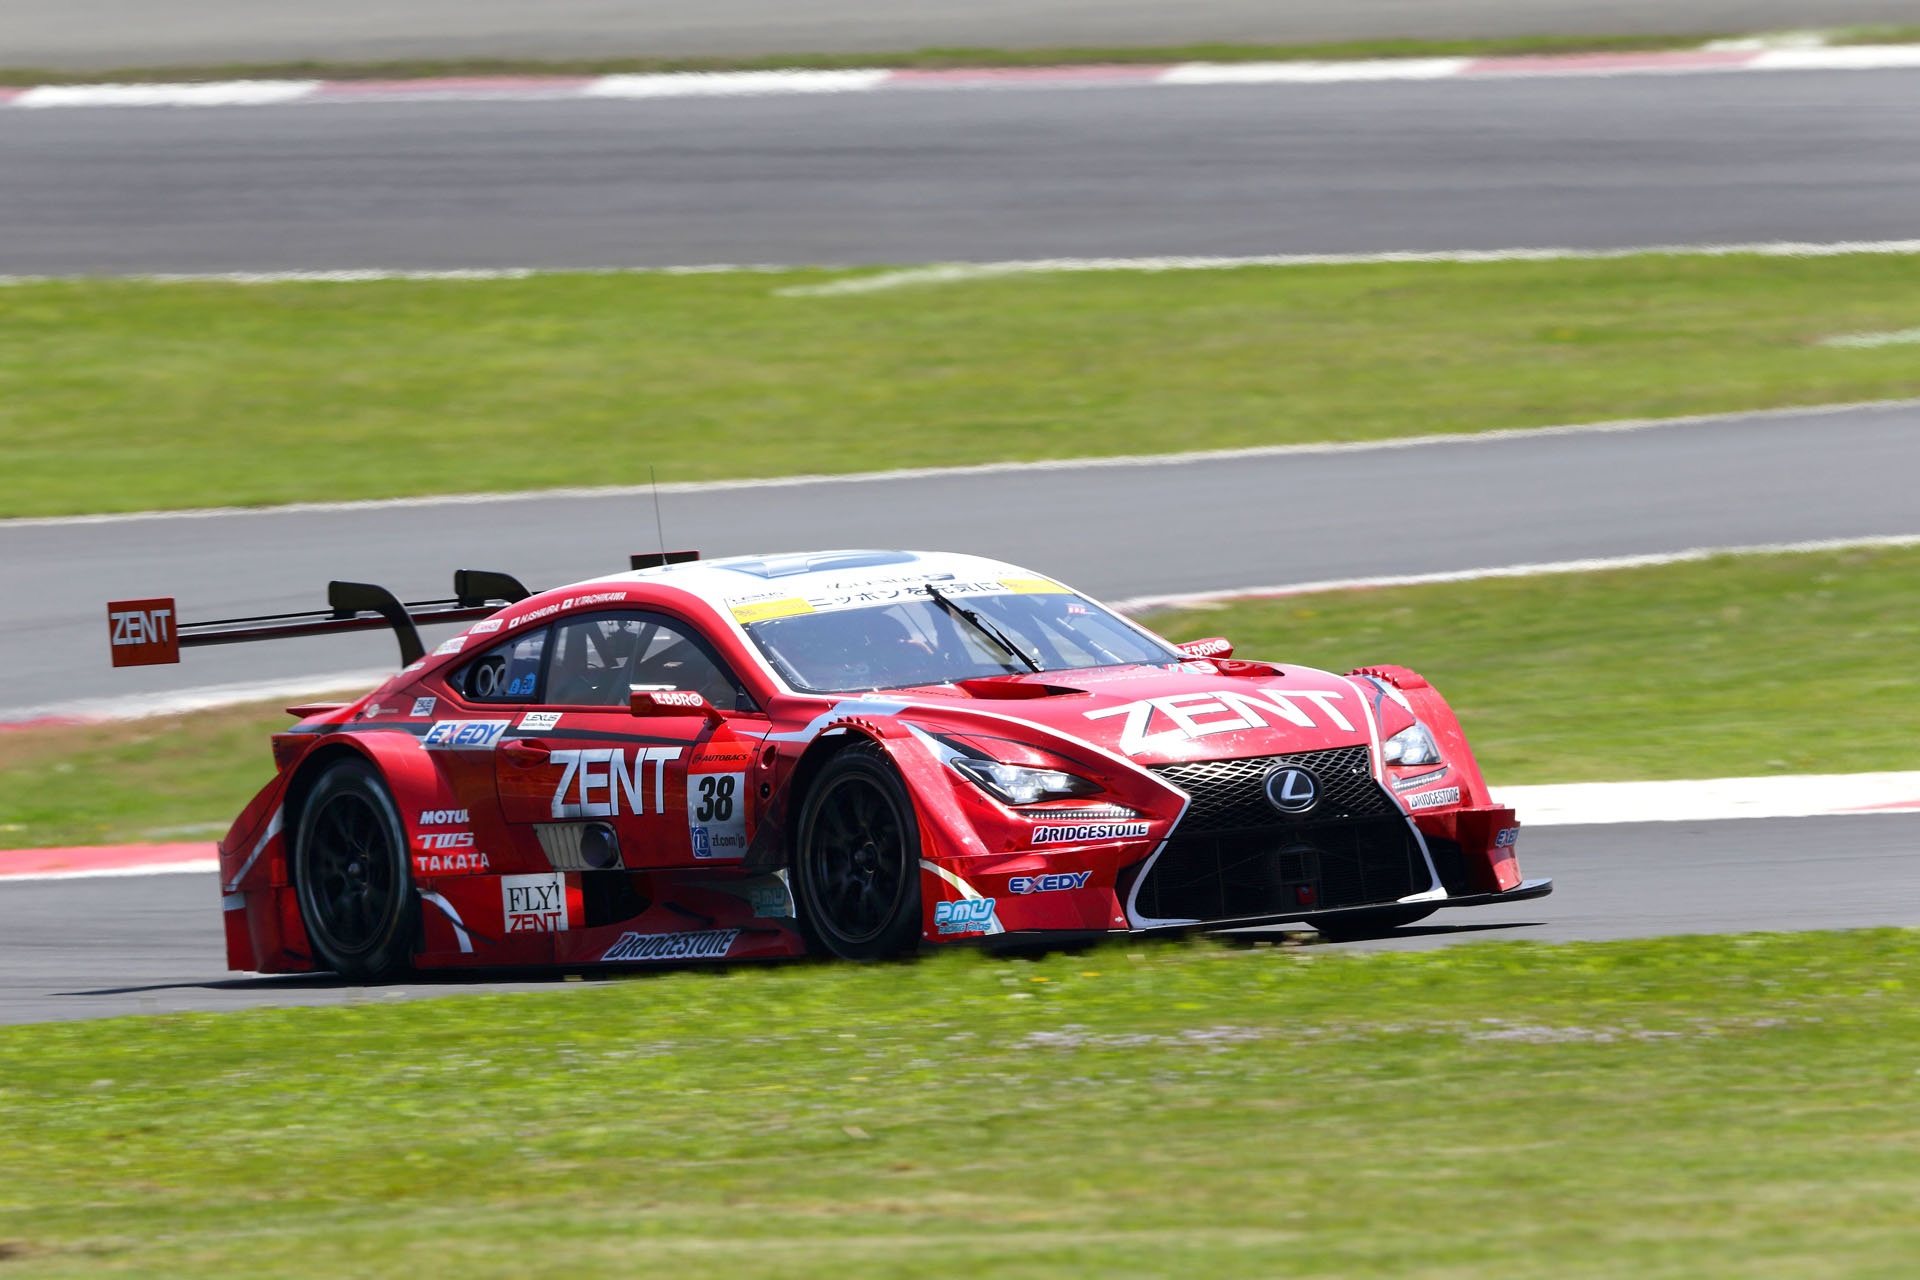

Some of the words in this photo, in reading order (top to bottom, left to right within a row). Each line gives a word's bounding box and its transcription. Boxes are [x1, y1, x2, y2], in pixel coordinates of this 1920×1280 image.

[110, 609, 171, 646] ZENT
[525, 713, 558, 722] LEXUS
[1083, 689, 1356, 757] ZENT
[424, 724, 505, 745] EXEDY
[702, 753, 748, 763] AUTOBACS
[550, 747, 683, 819] ZENT
[696, 775, 735, 822] 38
[1410, 787, 1460, 808] BRIDGESTONE
[420, 809, 470, 824] MOTUL
[416, 832, 474, 849] TWS
[1033, 822, 1148, 844] BRIDGESTONE
[417, 852, 490, 871] TAKATA
[1009, 871, 1093, 894] EXEDY
[507, 881, 561, 912] FLY!
[509, 912, 562, 934] ZENT
[604, 930, 737, 959] BRIDGESTONE
